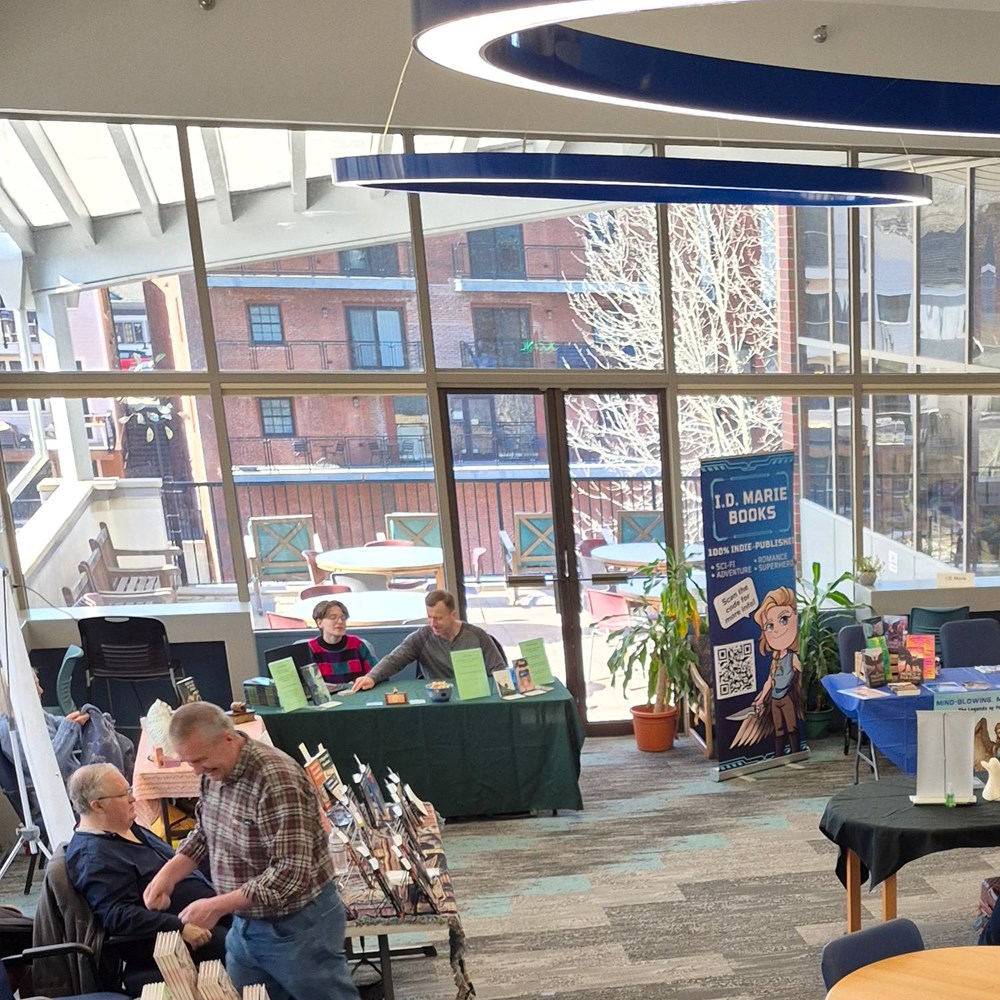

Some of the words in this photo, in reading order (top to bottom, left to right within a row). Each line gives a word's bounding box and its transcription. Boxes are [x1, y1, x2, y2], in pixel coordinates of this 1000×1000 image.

[715, 492, 738, 508] I.D.
[743, 487, 788, 505] MARIE
[729, 506, 776, 525] BOOKS
[708, 548, 730, 557] 100%
[758, 554, 788, 563] ROMANCE
[716, 561, 736, 570] SCI-FI
[716, 566, 752, 578] ADVENTURE
[722, 592, 738, 605] Scan
[738, 584, 749, 595] the
[726, 600, 742, 613] code
[740, 594, 751, 604] for
[724, 610, 742, 624] more
